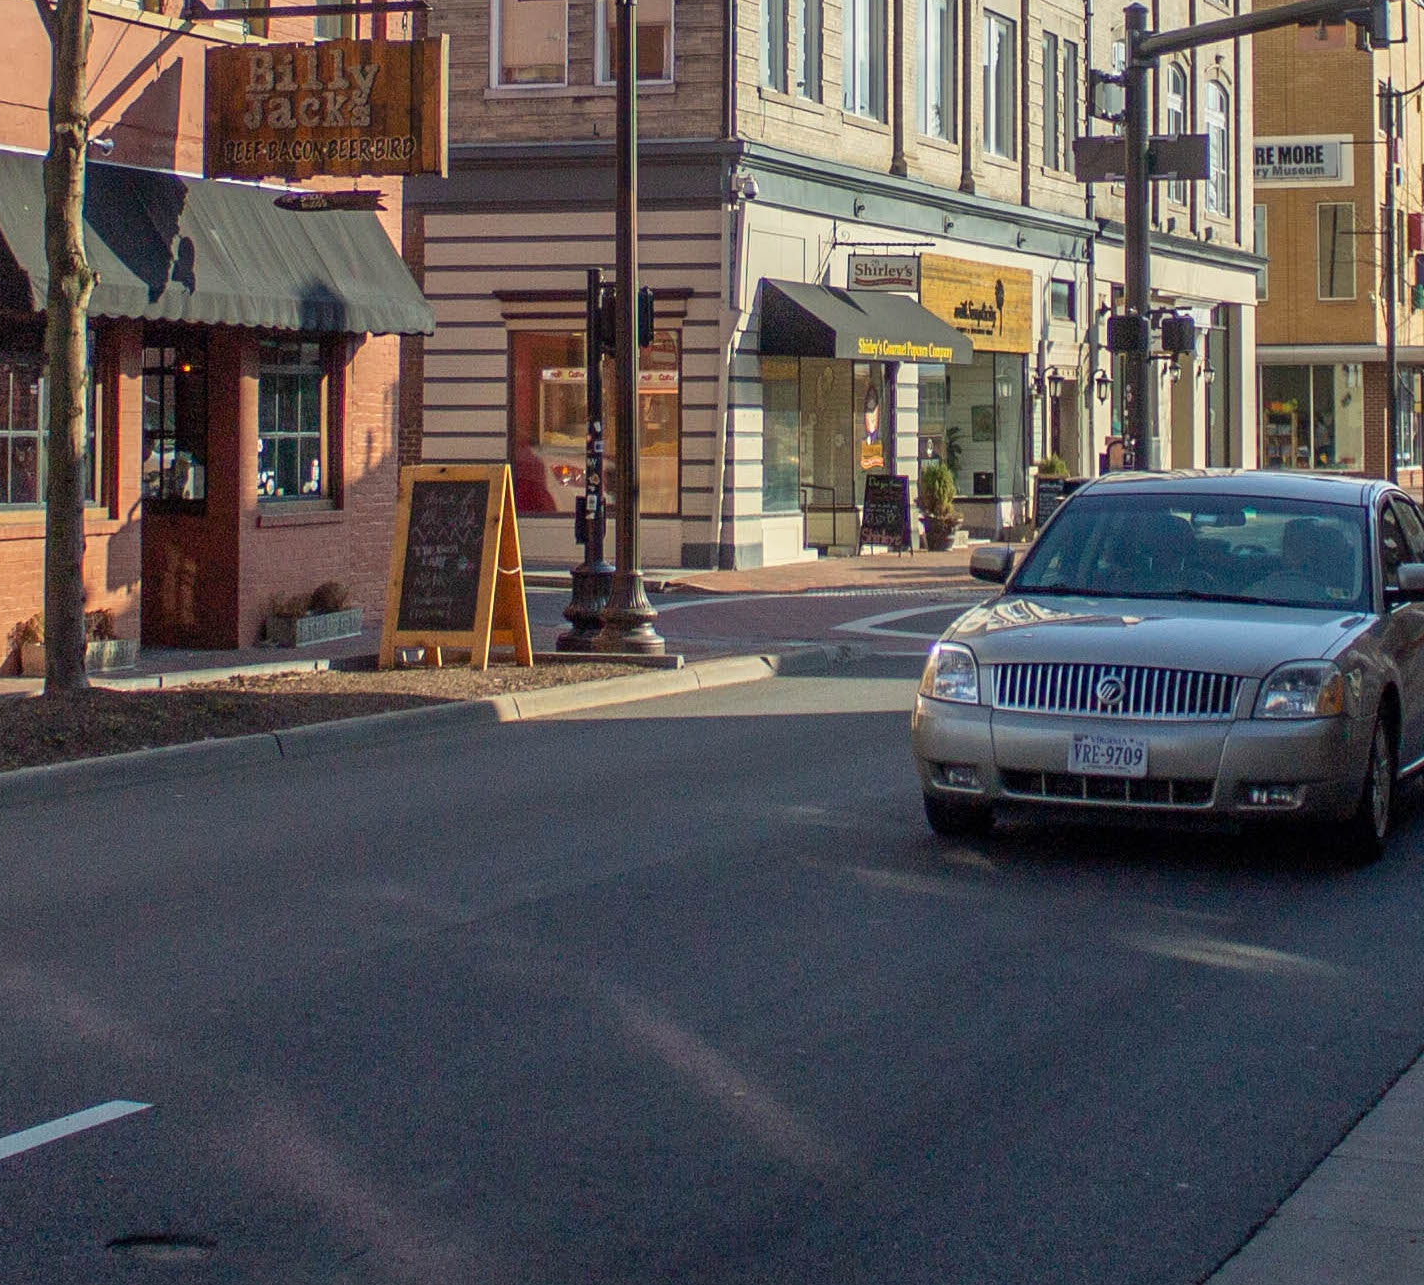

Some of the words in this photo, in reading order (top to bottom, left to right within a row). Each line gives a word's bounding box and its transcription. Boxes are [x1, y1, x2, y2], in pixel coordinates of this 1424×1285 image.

[245, 48, 380, 105] Billy
[1277, 144, 1324, 165] MORE
[1272, 165, 1325, 177] Museum
[854, 263, 913, 279] Shirley's
[858, 337, 884, 359] Shirley's
[883, 339, 907, 356] Gourmet
[907, 341, 928, 361] Popcorn
[928, 342, 953, 363] Company
[1074, 743, 1144, 766] VRE-9709
